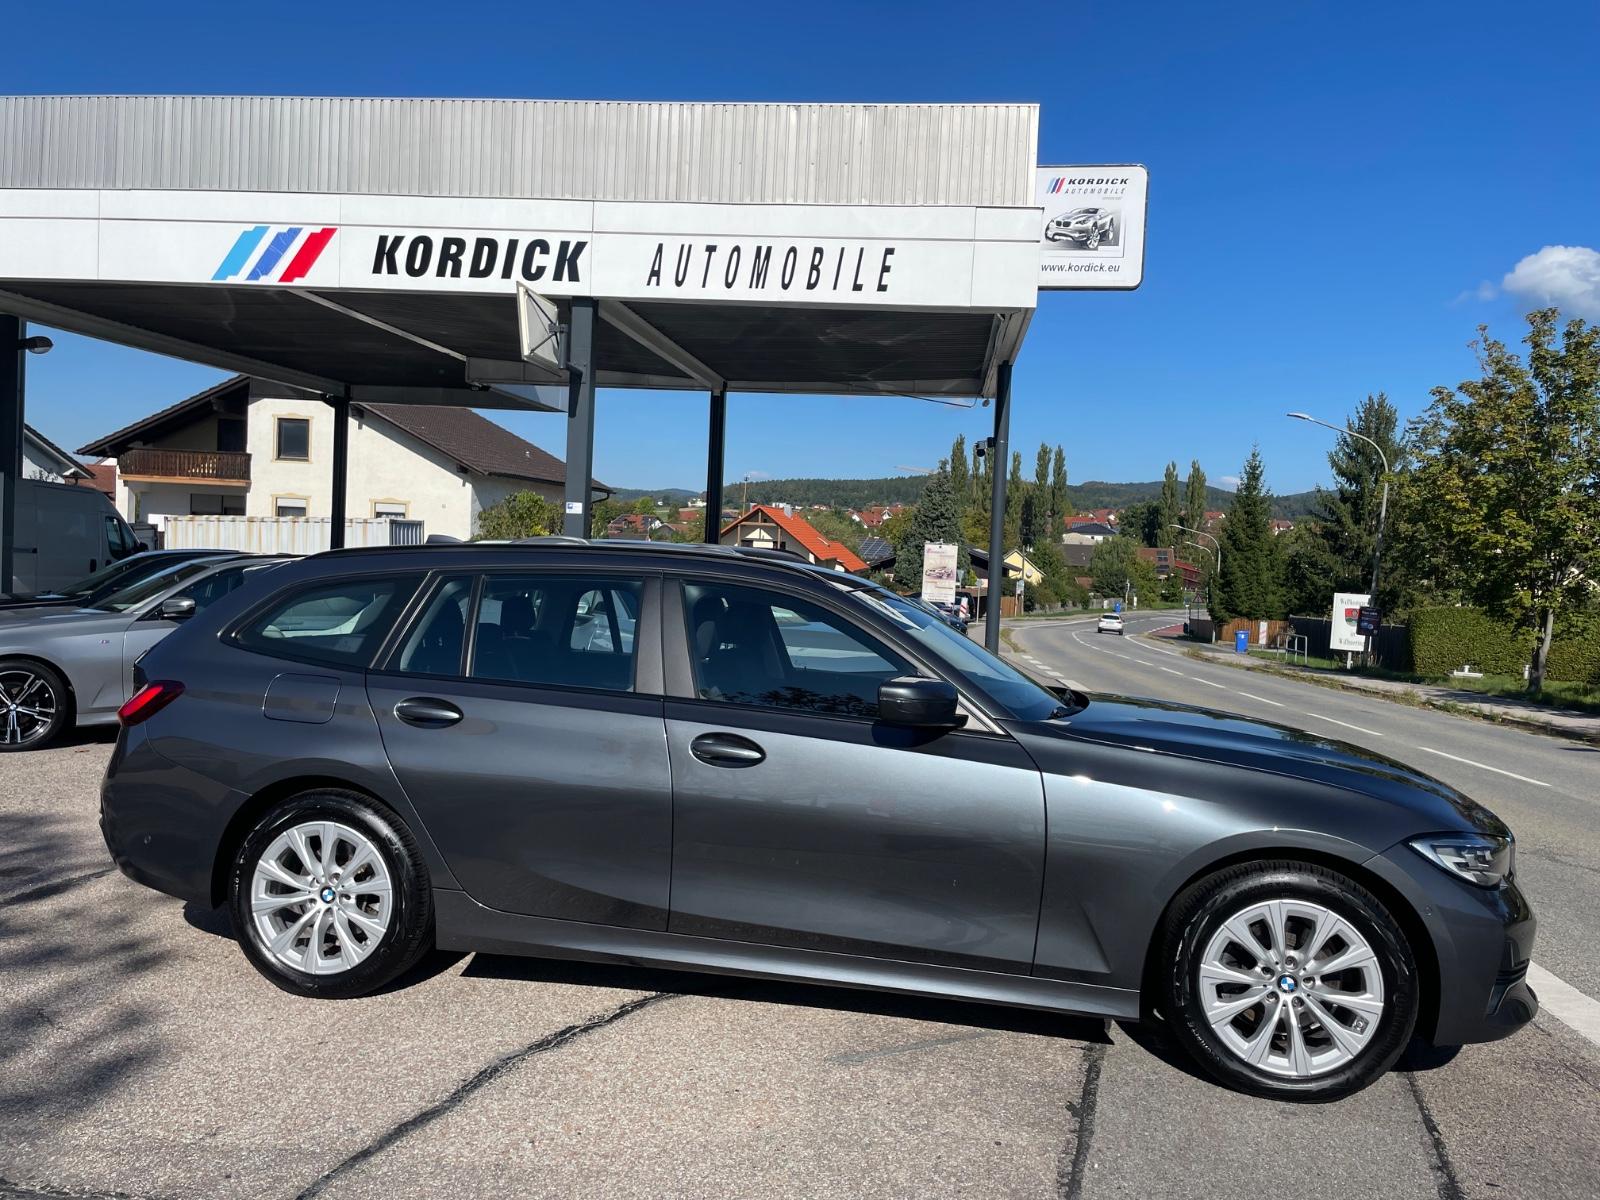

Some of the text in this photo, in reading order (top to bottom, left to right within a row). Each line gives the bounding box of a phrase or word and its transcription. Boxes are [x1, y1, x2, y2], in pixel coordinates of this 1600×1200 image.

[1064, 187, 1126, 195] AUTOMOBILE
[372, 234, 896, 292] KORDICK AUTOMOBILE
[1041, 262, 1120, 273] www.kordick.eu
